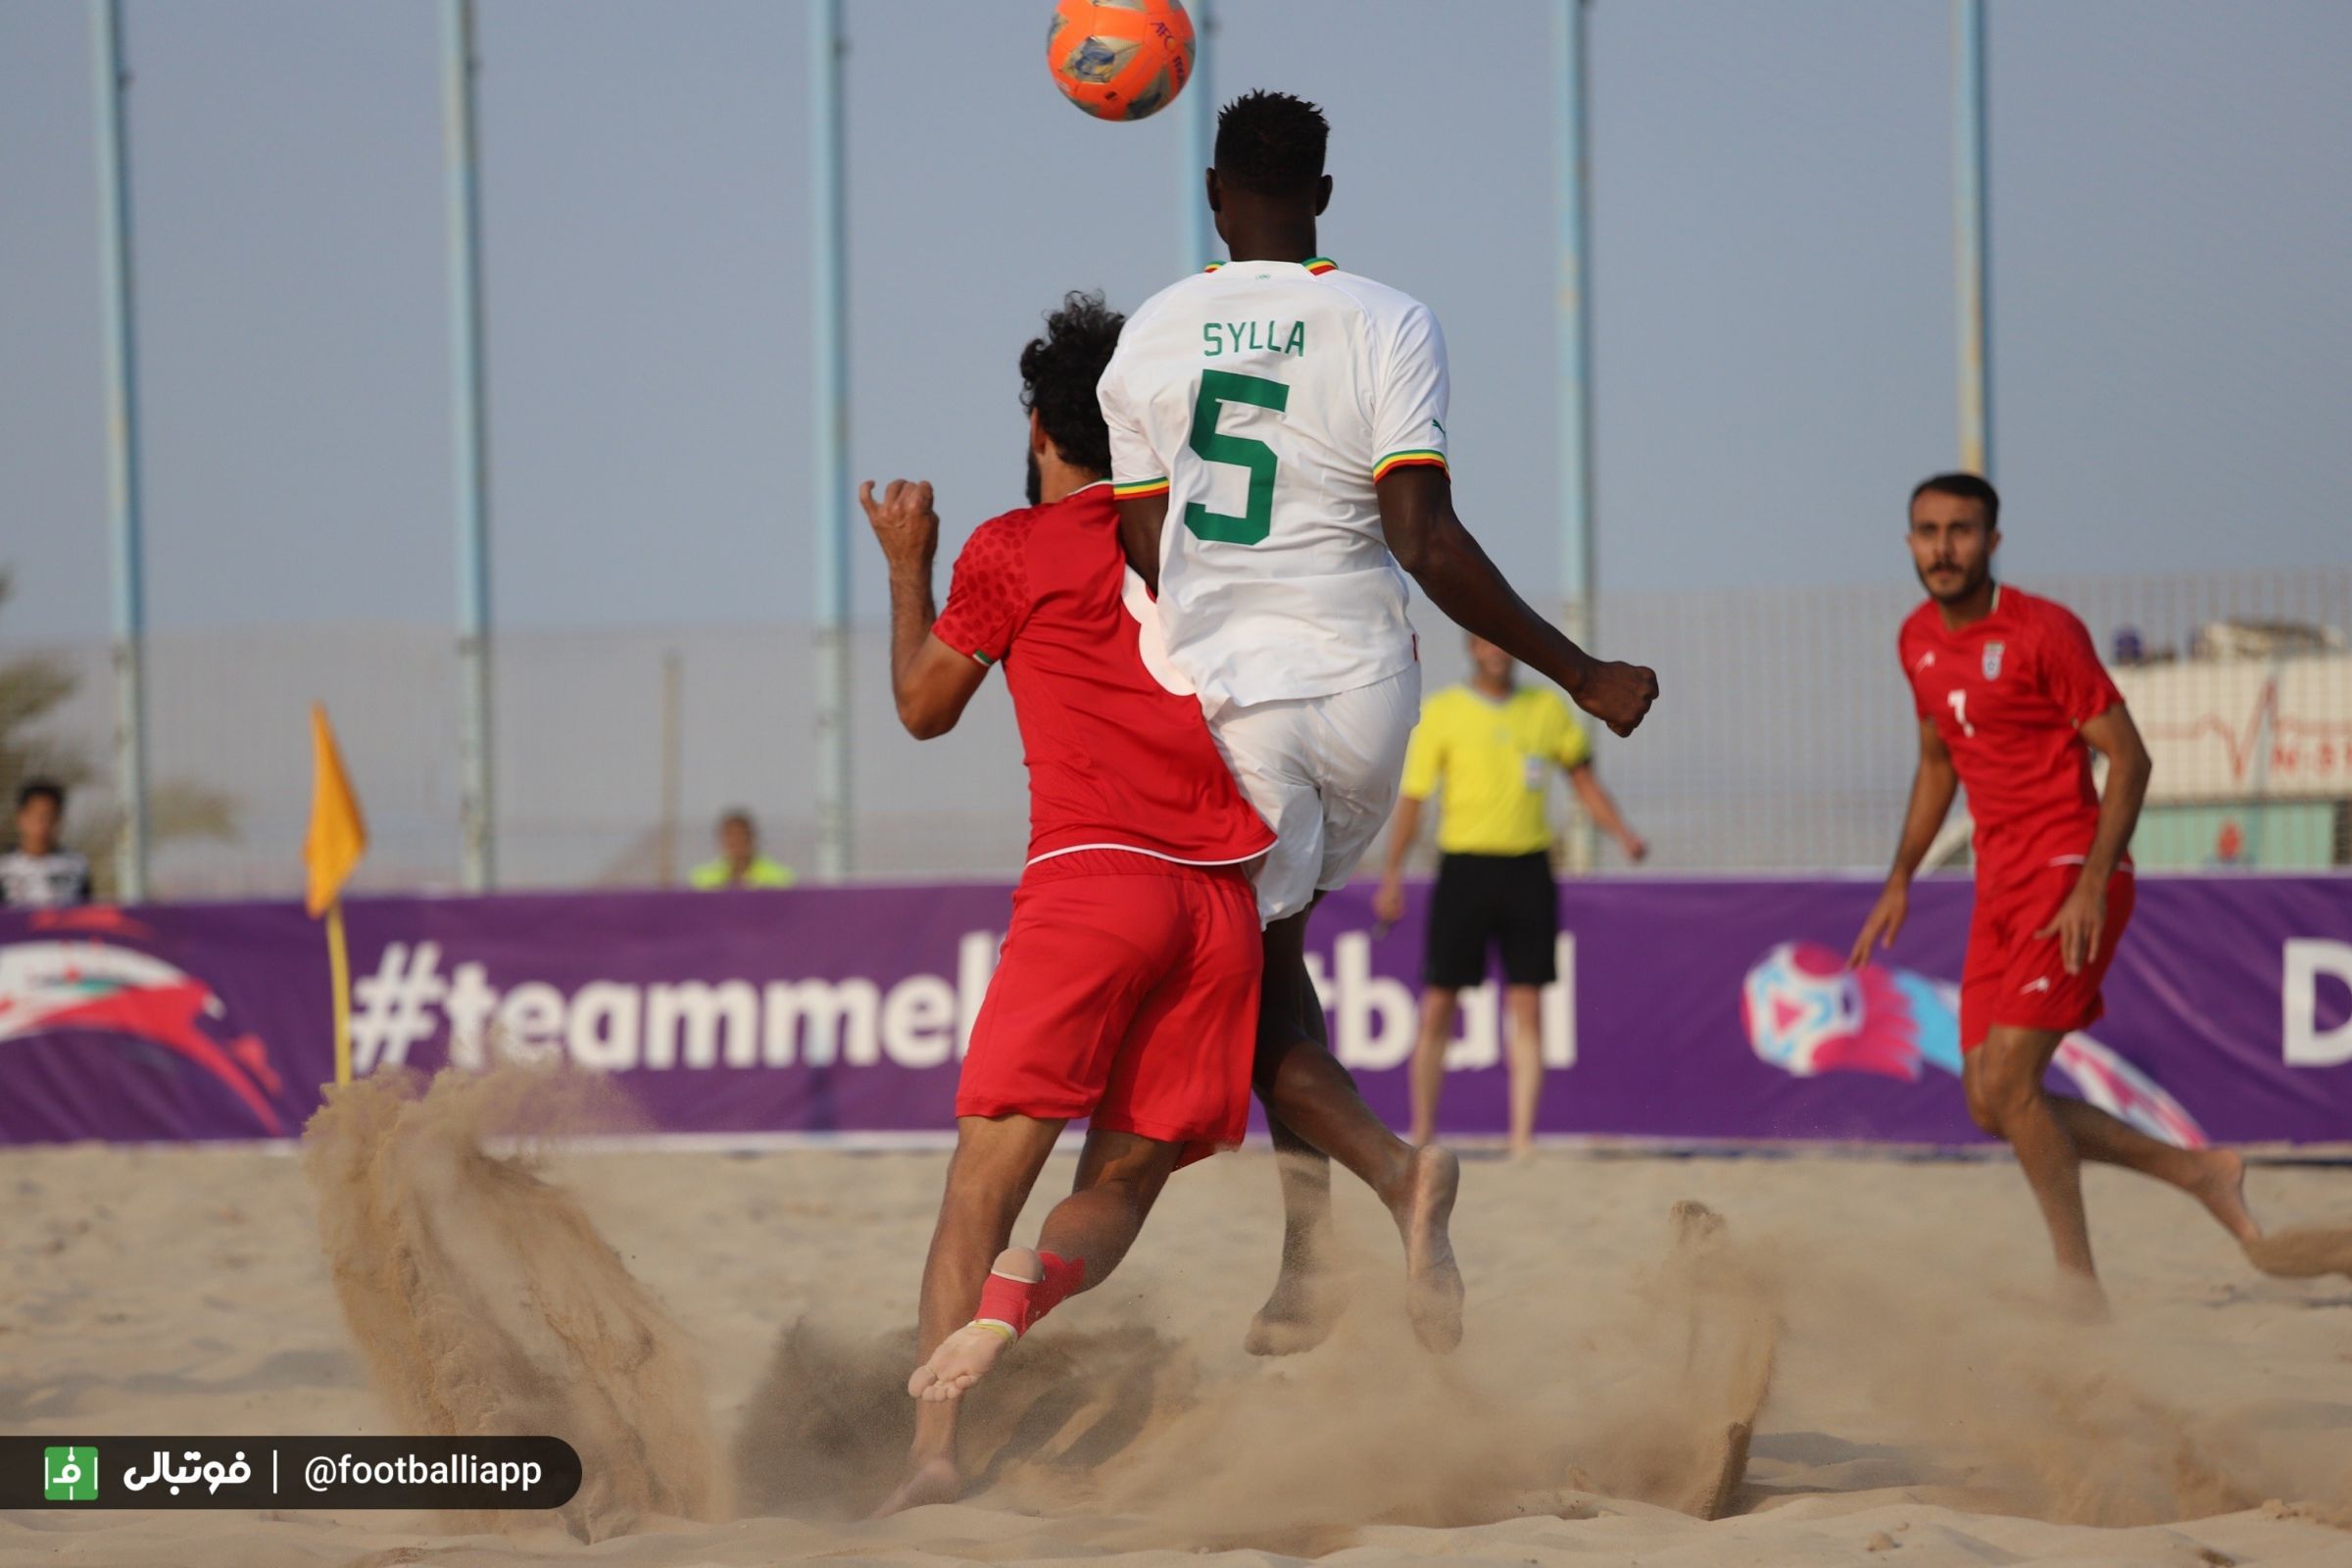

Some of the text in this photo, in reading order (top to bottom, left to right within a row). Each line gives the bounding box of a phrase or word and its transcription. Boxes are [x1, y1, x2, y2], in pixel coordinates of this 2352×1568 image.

[1202, 320, 1305, 358] SYLLA
[1184, 368, 1291, 547] 5
[1946, 689, 1976, 738] 7
